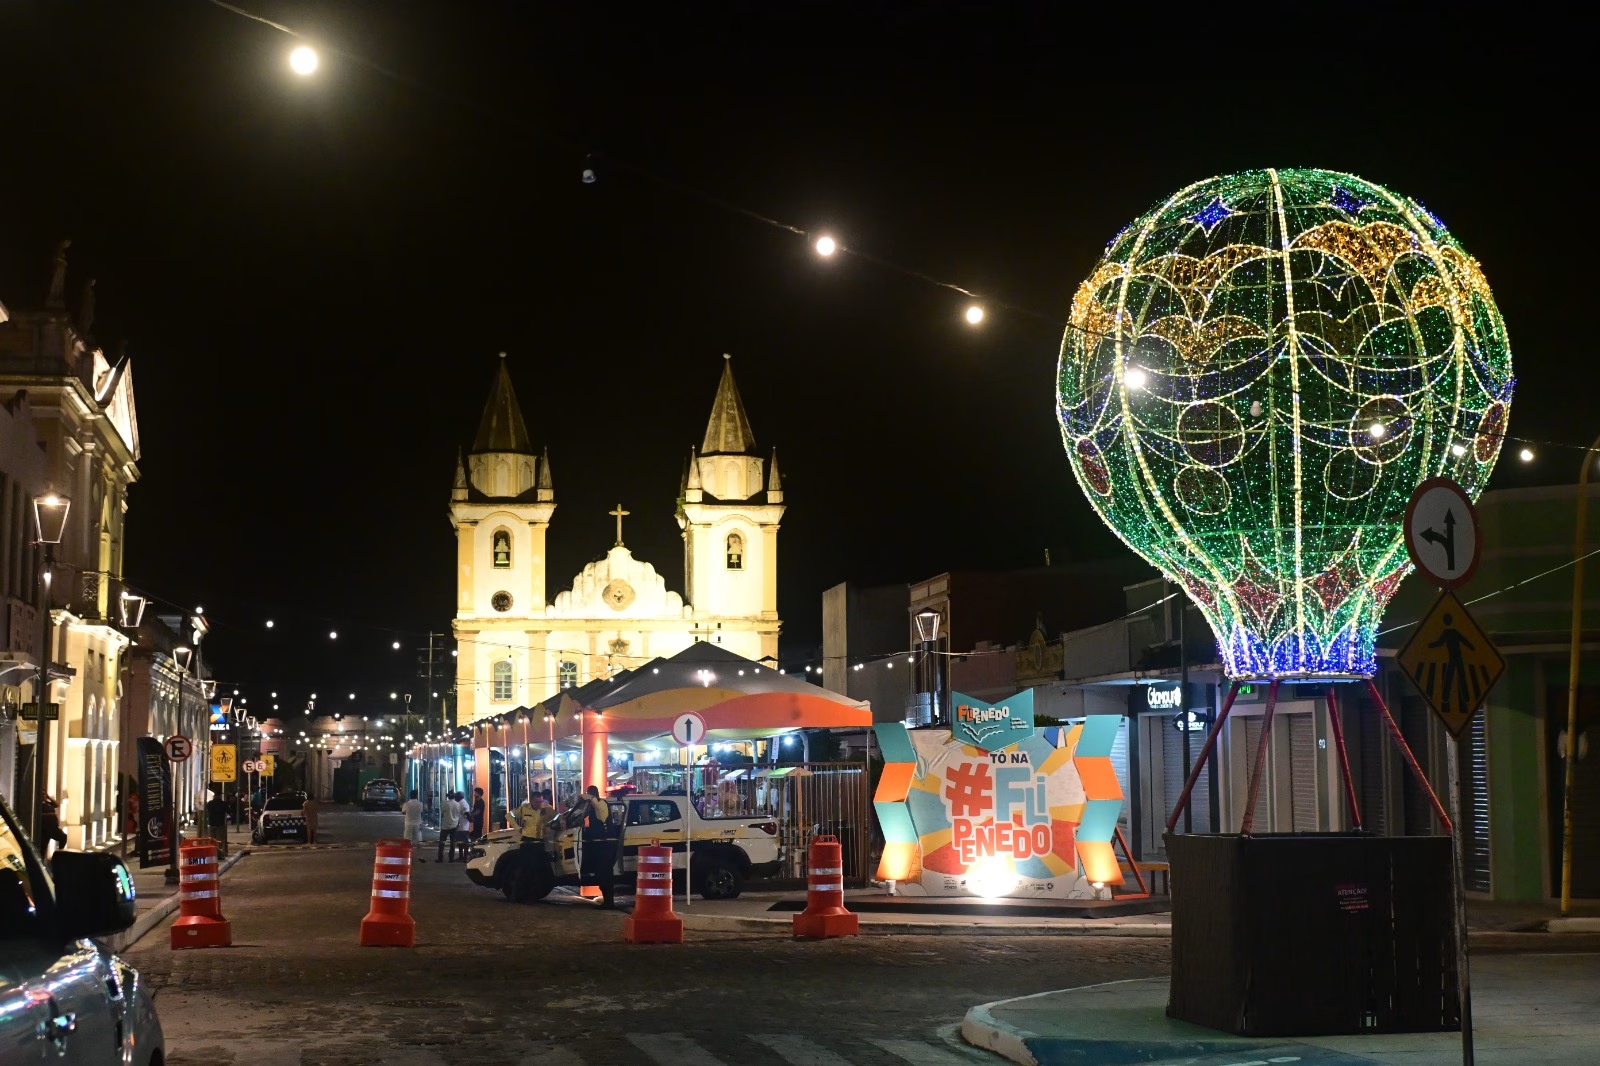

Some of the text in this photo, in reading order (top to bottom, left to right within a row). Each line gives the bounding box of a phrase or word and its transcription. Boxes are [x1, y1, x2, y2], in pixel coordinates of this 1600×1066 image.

[989, 751, 1029, 764] TÔ NA
[953, 818, 1051, 863] PENEDO
[188, 857, 206, 865] SMTT
